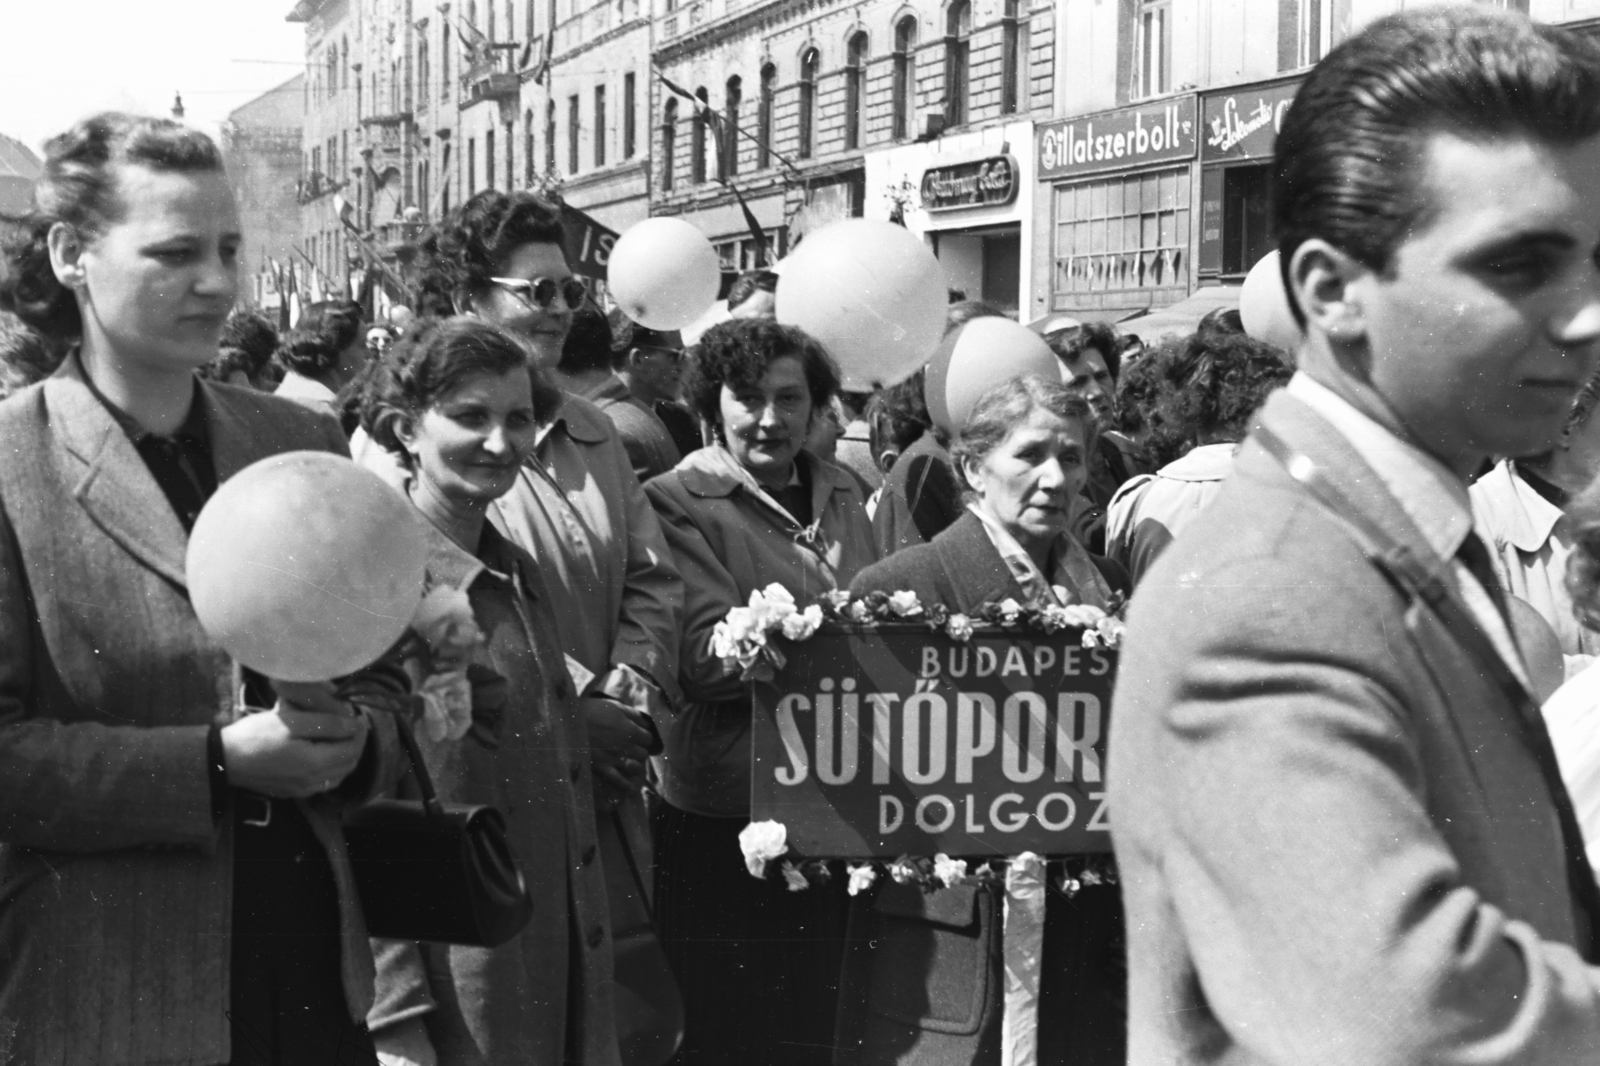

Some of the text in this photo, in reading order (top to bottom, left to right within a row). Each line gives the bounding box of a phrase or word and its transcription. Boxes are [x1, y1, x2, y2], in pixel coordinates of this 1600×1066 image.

[921, 645, 1110, 678] BUDAPES
[774, 677, 1102, 786] SÜTŐPOR
[879, 791, 1113, 834] DOLGOZ
